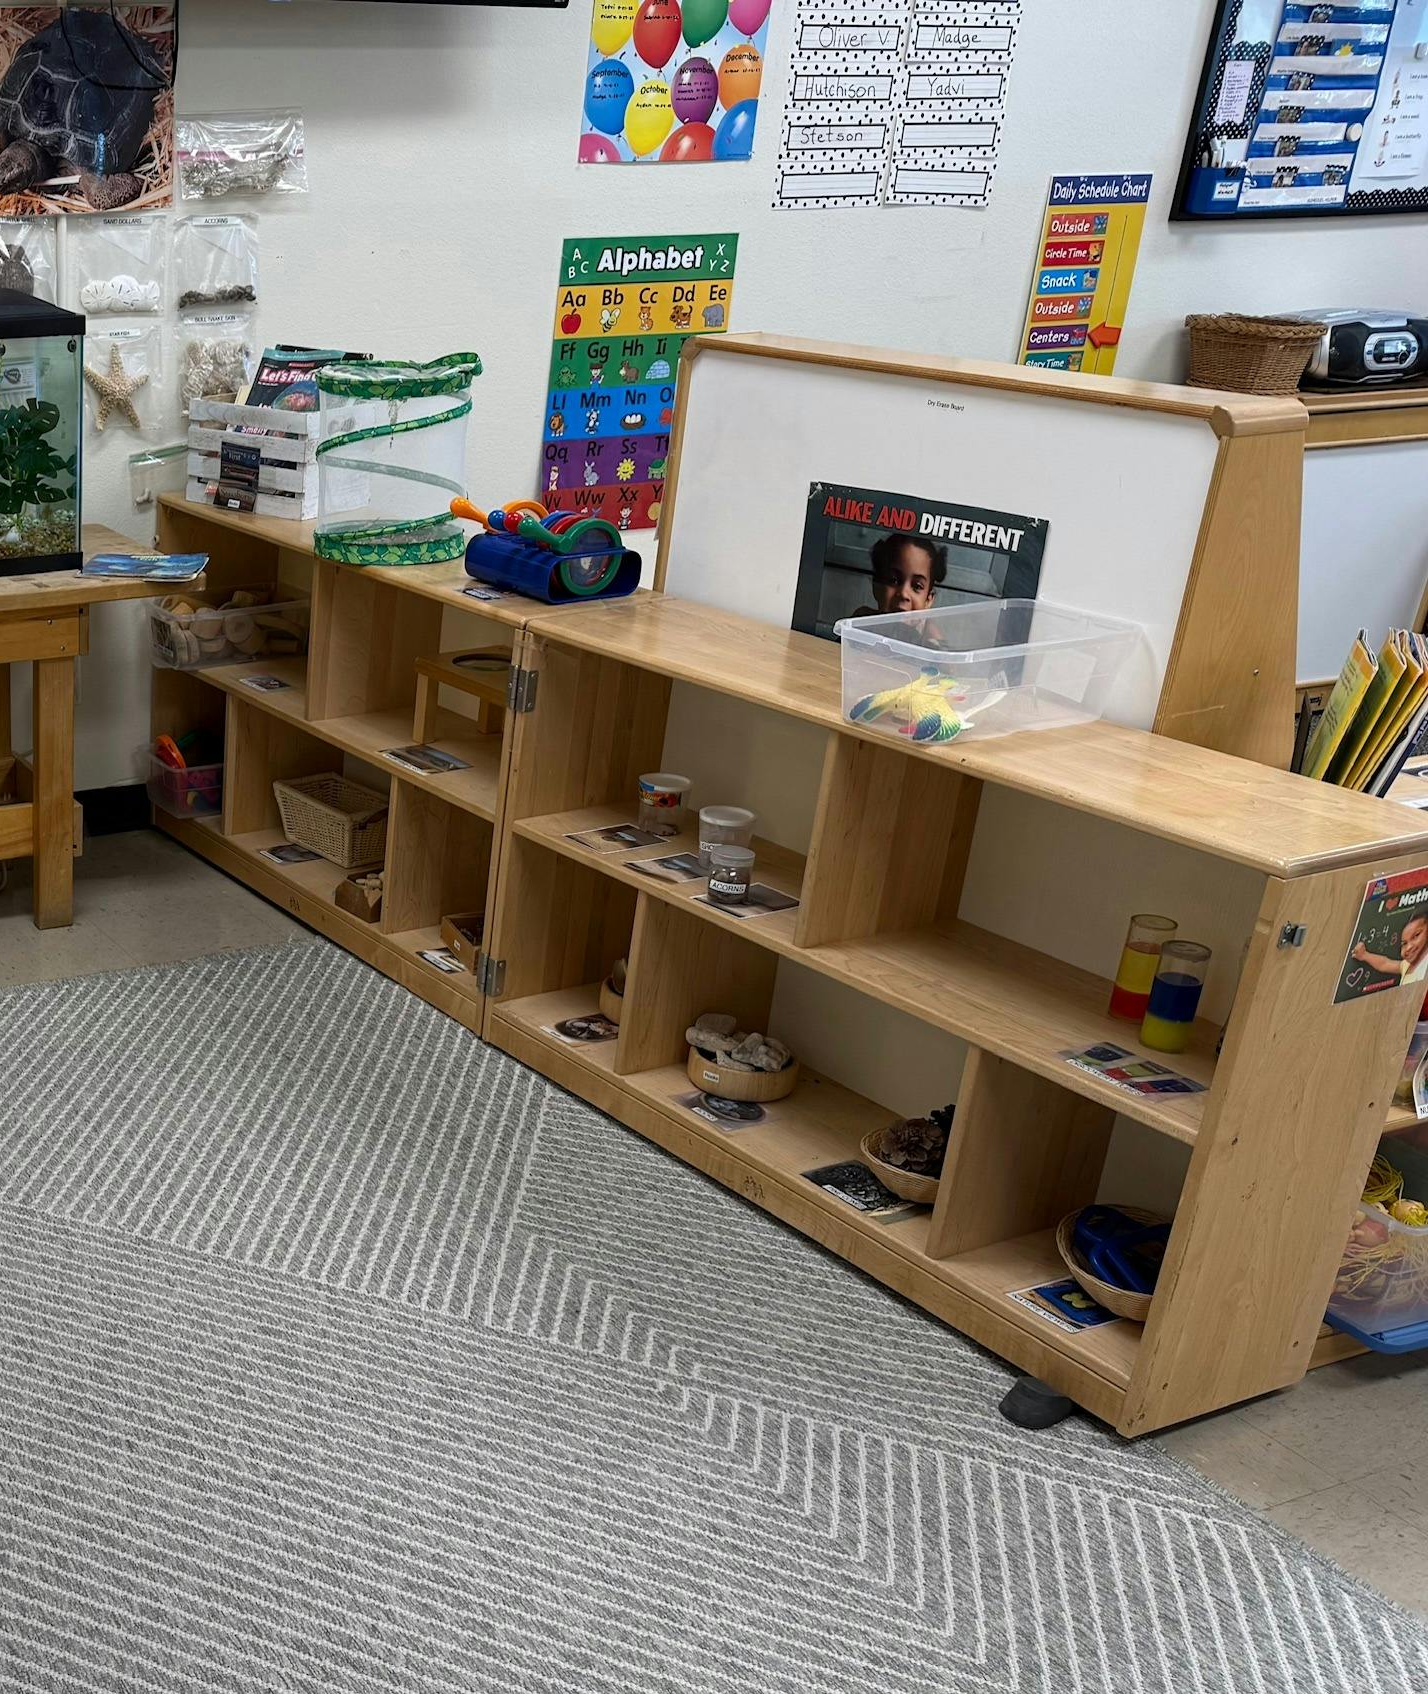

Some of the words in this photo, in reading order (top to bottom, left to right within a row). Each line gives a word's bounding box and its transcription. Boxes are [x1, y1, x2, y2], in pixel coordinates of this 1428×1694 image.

[819, 25, 867, 48] Oliver
[932, 27, 981, 48] Madge
[725, 52, 760, 63] December
[591, 69, 629, 79] September
[679, 66, 714, 75] November
[640, 86, 668, 95] October
[805, 75, 876, 99] Hutchison
[927, 77, 965, 96] Yadvi
[800, 126, 864, 145] Stetson
[1053, 181, 1077, 203] Daily
[1078, 179, 1119, 199] Schedule
[1121, 179, 1147, 197] Chart
[1051, 220, 1091, 233] Outside
[573, 248, 582, 261] A
[716, 243, 726, 256] X
[1045, 248, 1067, 258] Circle
[1068, 247, 1088, 257] Time
[596, 245, 705, 276] Alphabet
[709, 259, 717, 272] Y
[720, 259, 729, 272] Z
[568, 266, 575, 279] B
[580, 260, 589, 274] C
[1041, 273, 1077, 289] Snack
[561, 290, 586, 307] Aa
[602, 287, 624, 305] Bb
[639, 287, 658, 304] Cc
[672, 284, 695, 302] Dd
[709, 284, 727, 301] Ee
[1035, 301, 1075, 315] Outside
[1029, 331, 1070, 344] Centers
[560, 341, 576, 360] Ff
[587, 341, 610, 363] Gg
[622, 338, 644, 357] Hh
[655, 337, 667, 355] Ii
[1046, 359, 1065, 368] Time
[260, 367, 287, 381] Let's
[580, 392, 611, 408] Mm
[624, 389, 646, 406] Nn
[660, 386, 675, 403] O
[546, 444, 568, 463] Qq
[586, 441, 604, 457] Rr
[621, 438, 638, 454] Ss
[544, 494, 561, 509] Vv
[574, 489, 606, 506] Ww
[619, 487, 639, 503] Xx
[822, 495, 875, 524] ALIKE
[876, 505, 916, 531] AND
[919, 513, 1024, 552] DIFFERENT
[712, 881, 744, 893] ACORNS
[1399, 888, 1428, 907] Math
